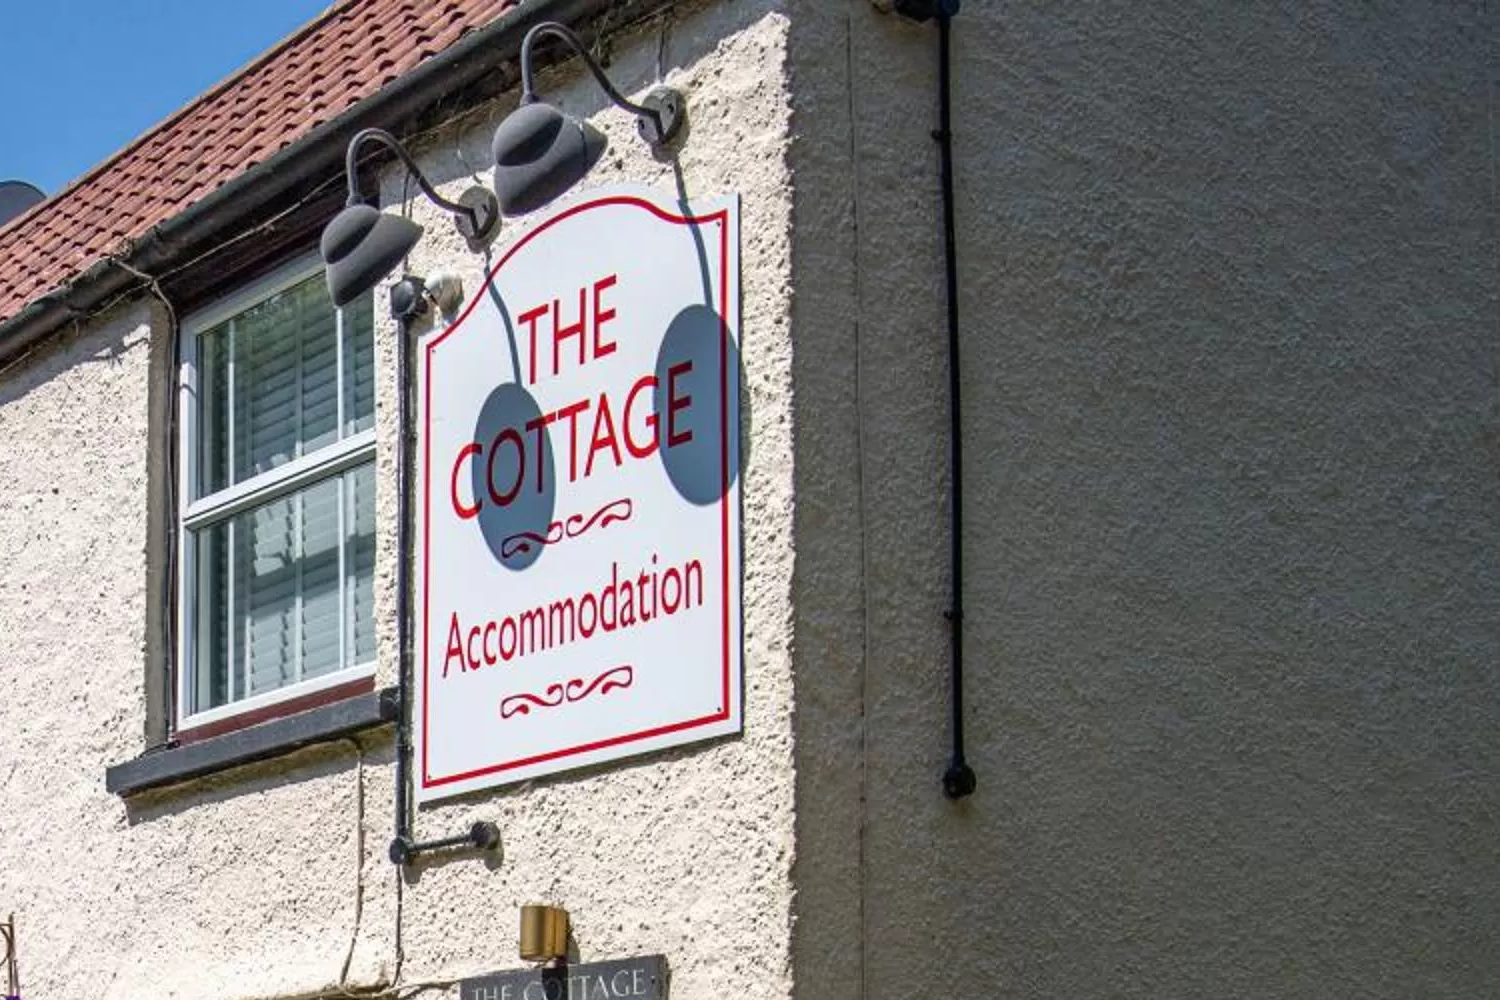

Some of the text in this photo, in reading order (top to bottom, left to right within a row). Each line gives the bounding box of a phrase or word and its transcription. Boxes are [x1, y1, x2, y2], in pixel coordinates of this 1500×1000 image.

[518, 274, 617, 385] THE
[451, 360, 693, 519] COTTAGE
[443, 555, 703, 678] Accommodation
